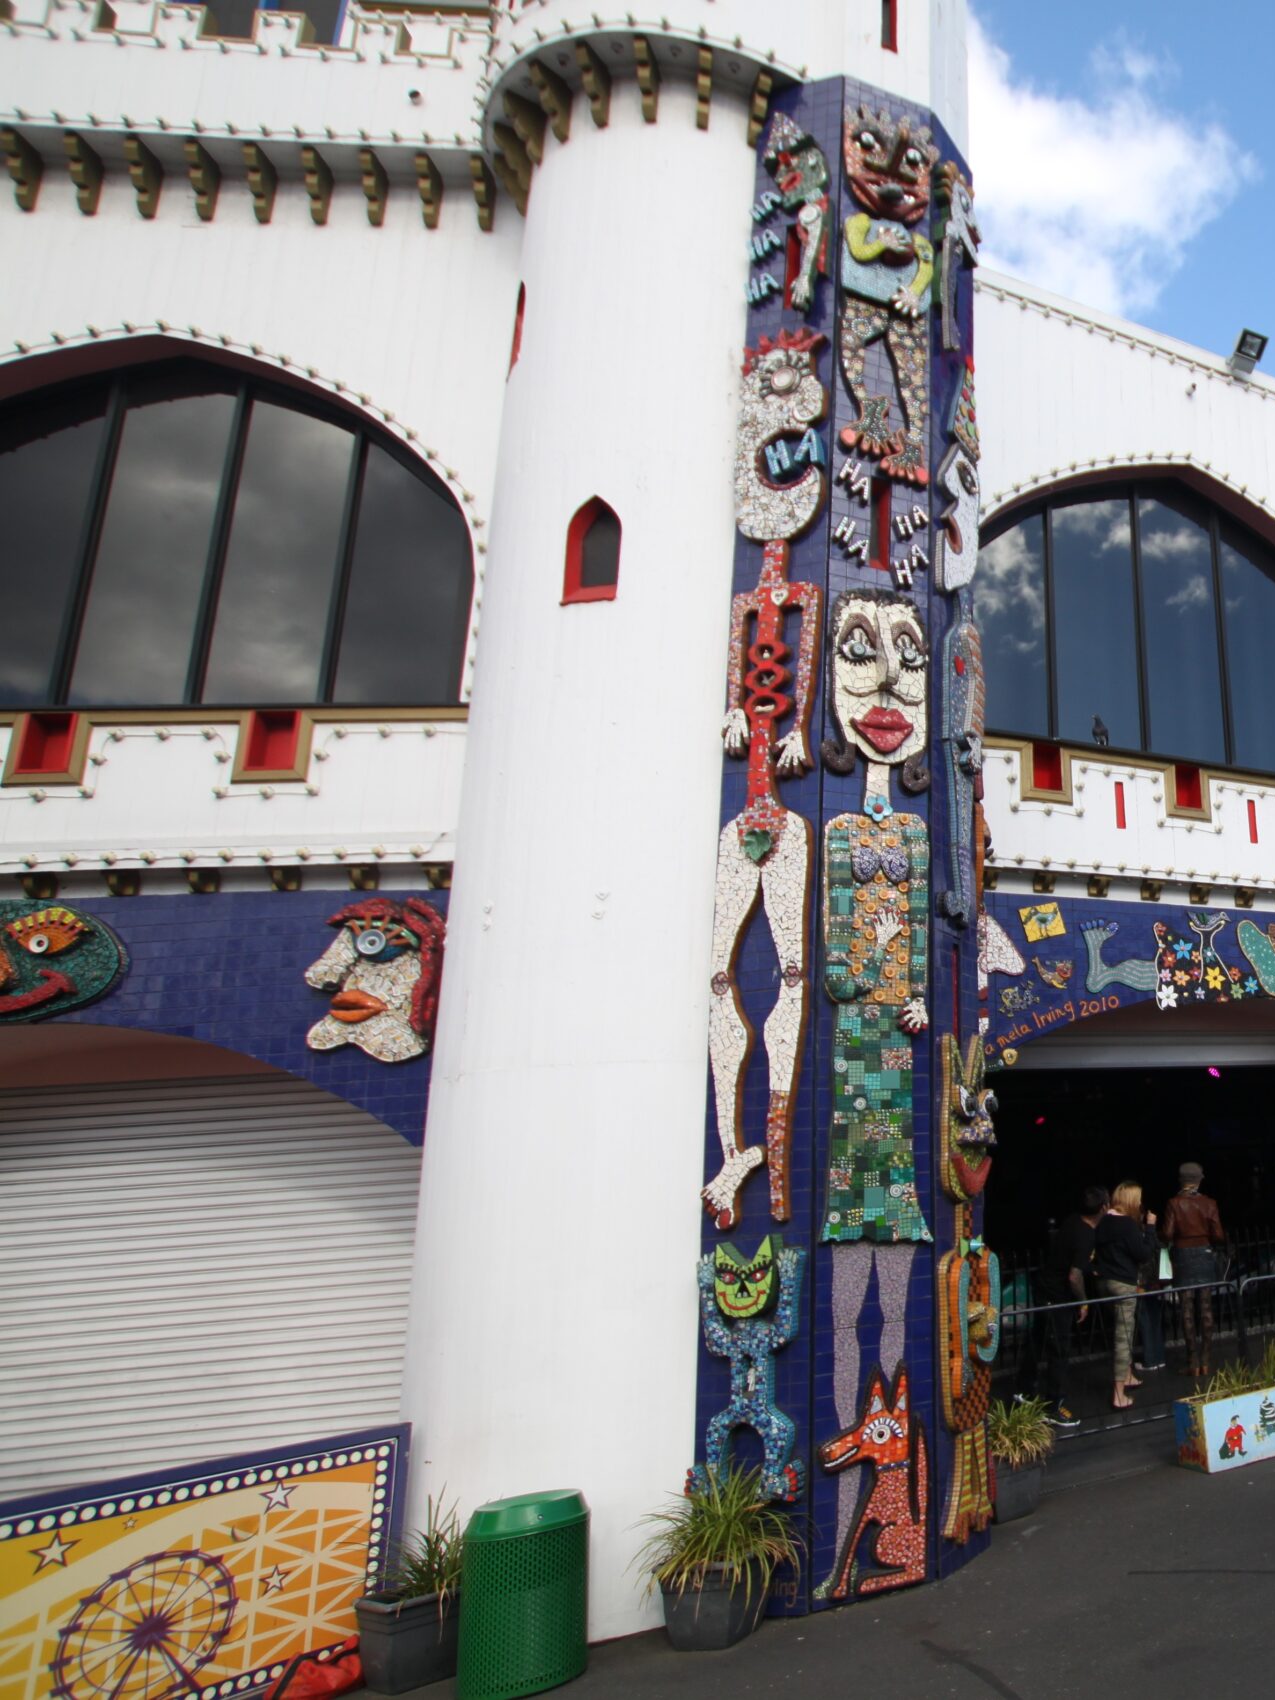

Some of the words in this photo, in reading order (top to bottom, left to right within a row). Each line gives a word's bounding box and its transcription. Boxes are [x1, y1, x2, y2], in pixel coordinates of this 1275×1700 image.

[744, 272, 780, 303] HA
[764, 428, 823, 477] HA
[839, 457, 870, 501] HA
[834, 516, 870, 561] HA
[895, 505, 929, 537] HA
[894, 543, 930, 586] HA
[984, 1023, 1033, 1055] amela
[1032, 1000, 1075, 1029] Irving
[1079, 995, 1120, 1017] 2010
